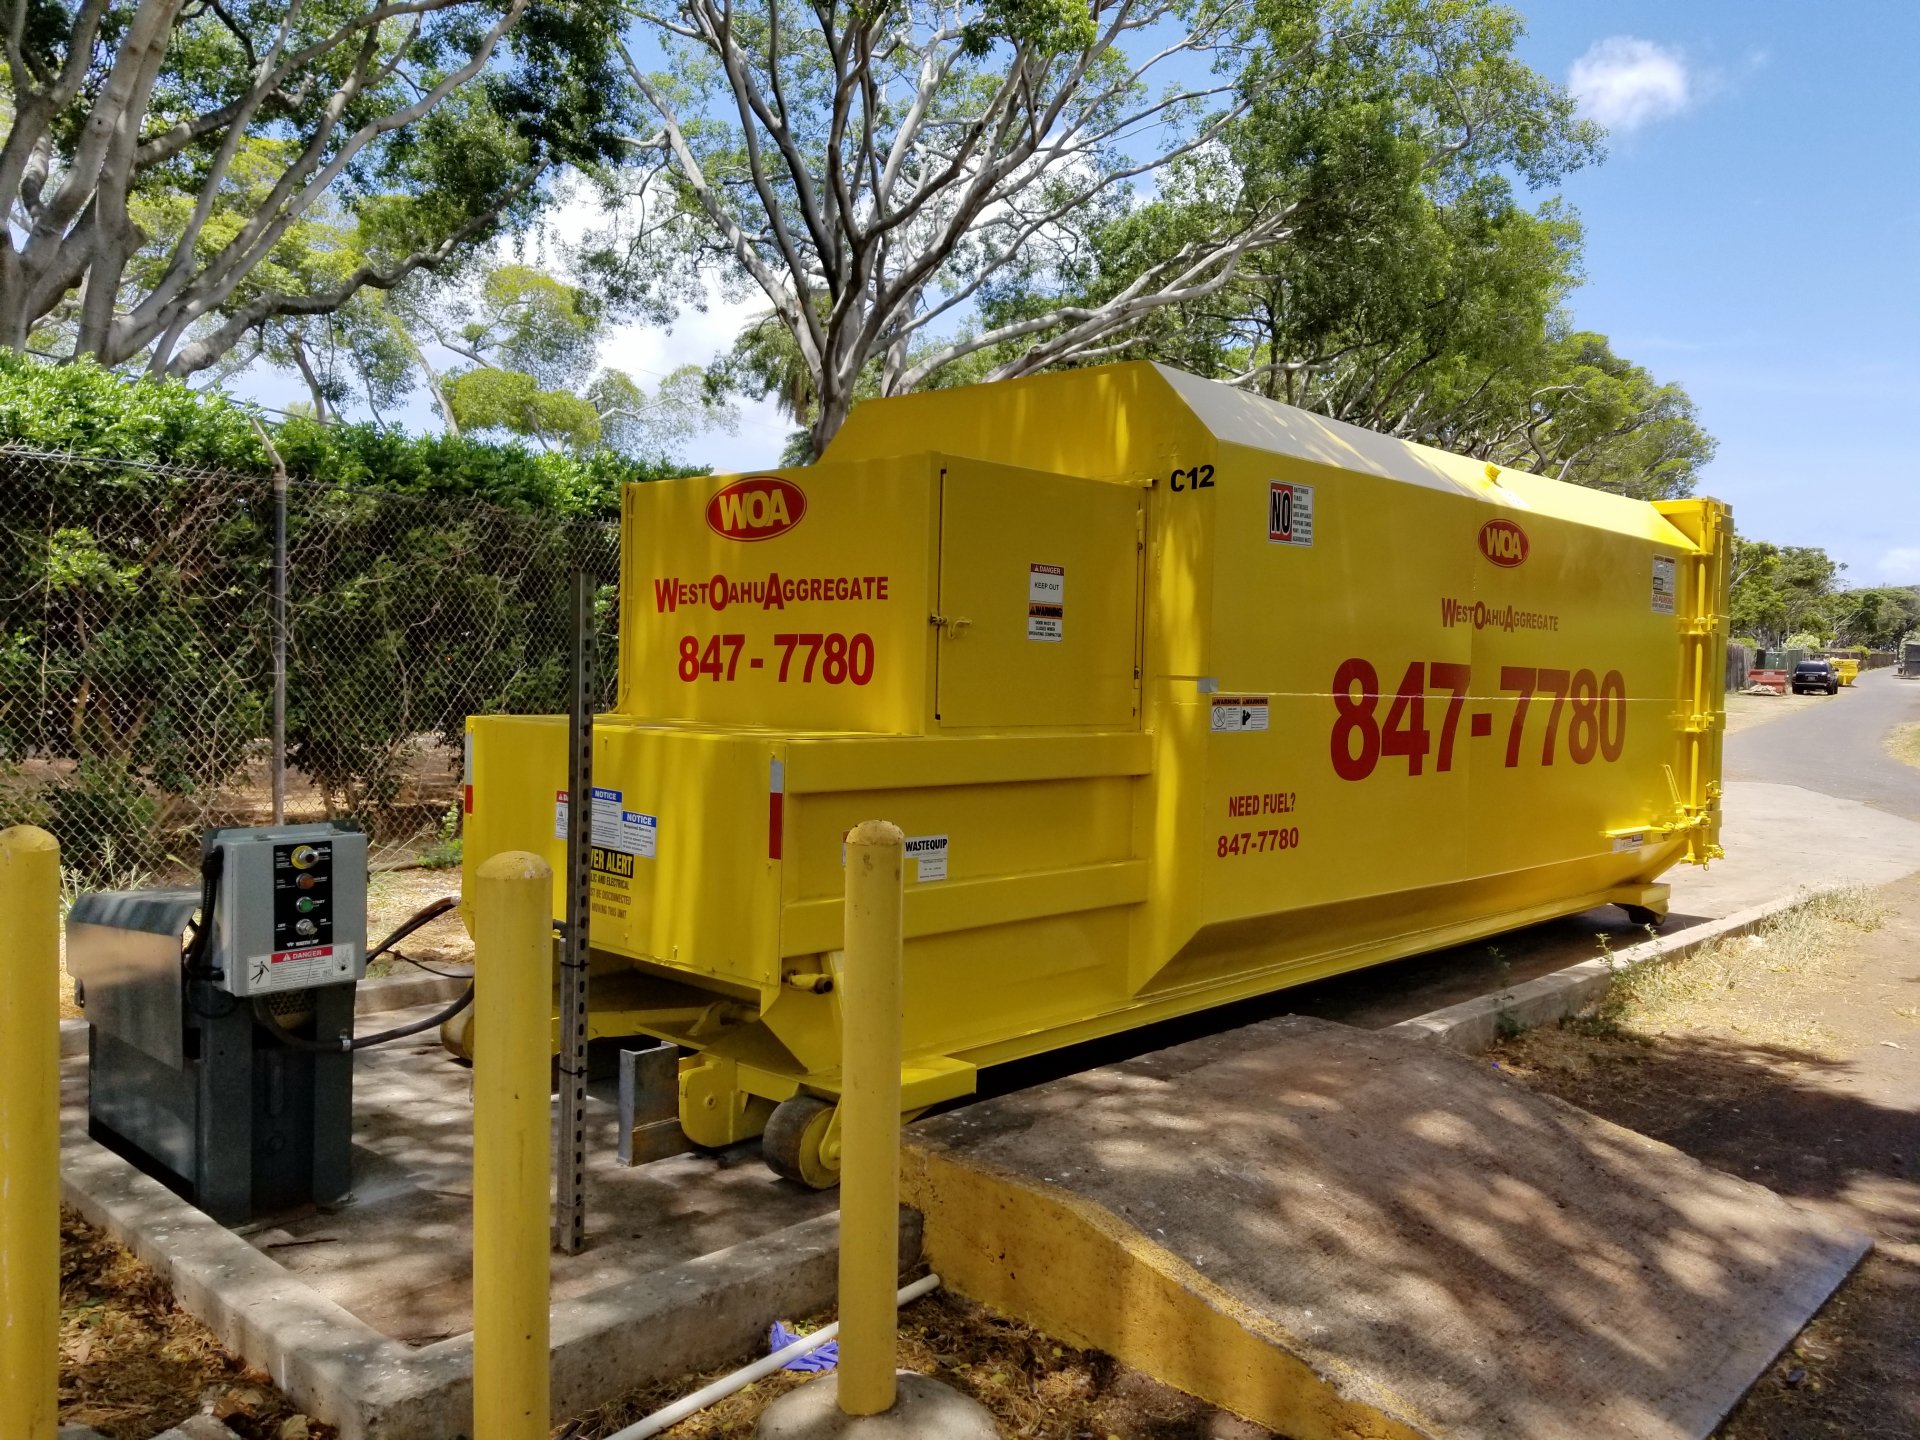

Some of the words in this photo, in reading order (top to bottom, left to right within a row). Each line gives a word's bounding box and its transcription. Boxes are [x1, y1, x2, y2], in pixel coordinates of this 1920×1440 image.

[1170, 464, 1215, 492] C12
[718, 488, 791, 531] WOA
[1271, 488, 1292, 536] NO
[1485, 526, 1523, 560] WOA
[1039, 565, 1061, 575] DANGER
[1034, 581, 1048, 590] KEEP
[1048, 583, 1060, 591] OUT
[1034, 604, 1063, 618] WARNING
[1330, 657, 1627, 782] 847-7780
[595, 790, 617, 801] NOTICE
[1229, 795, 1260, 818] NEED
[1263, 792, 1296, 815] FUEL?
[626, 812, 653, 826] NOTICE
[905, 838, 948, 852] WASTEQUIP
[1217, 826, 1299, 858] 847-7780
[605, 851, 633, 876] ALERT
[292, 949, 322, 960] DANGER
